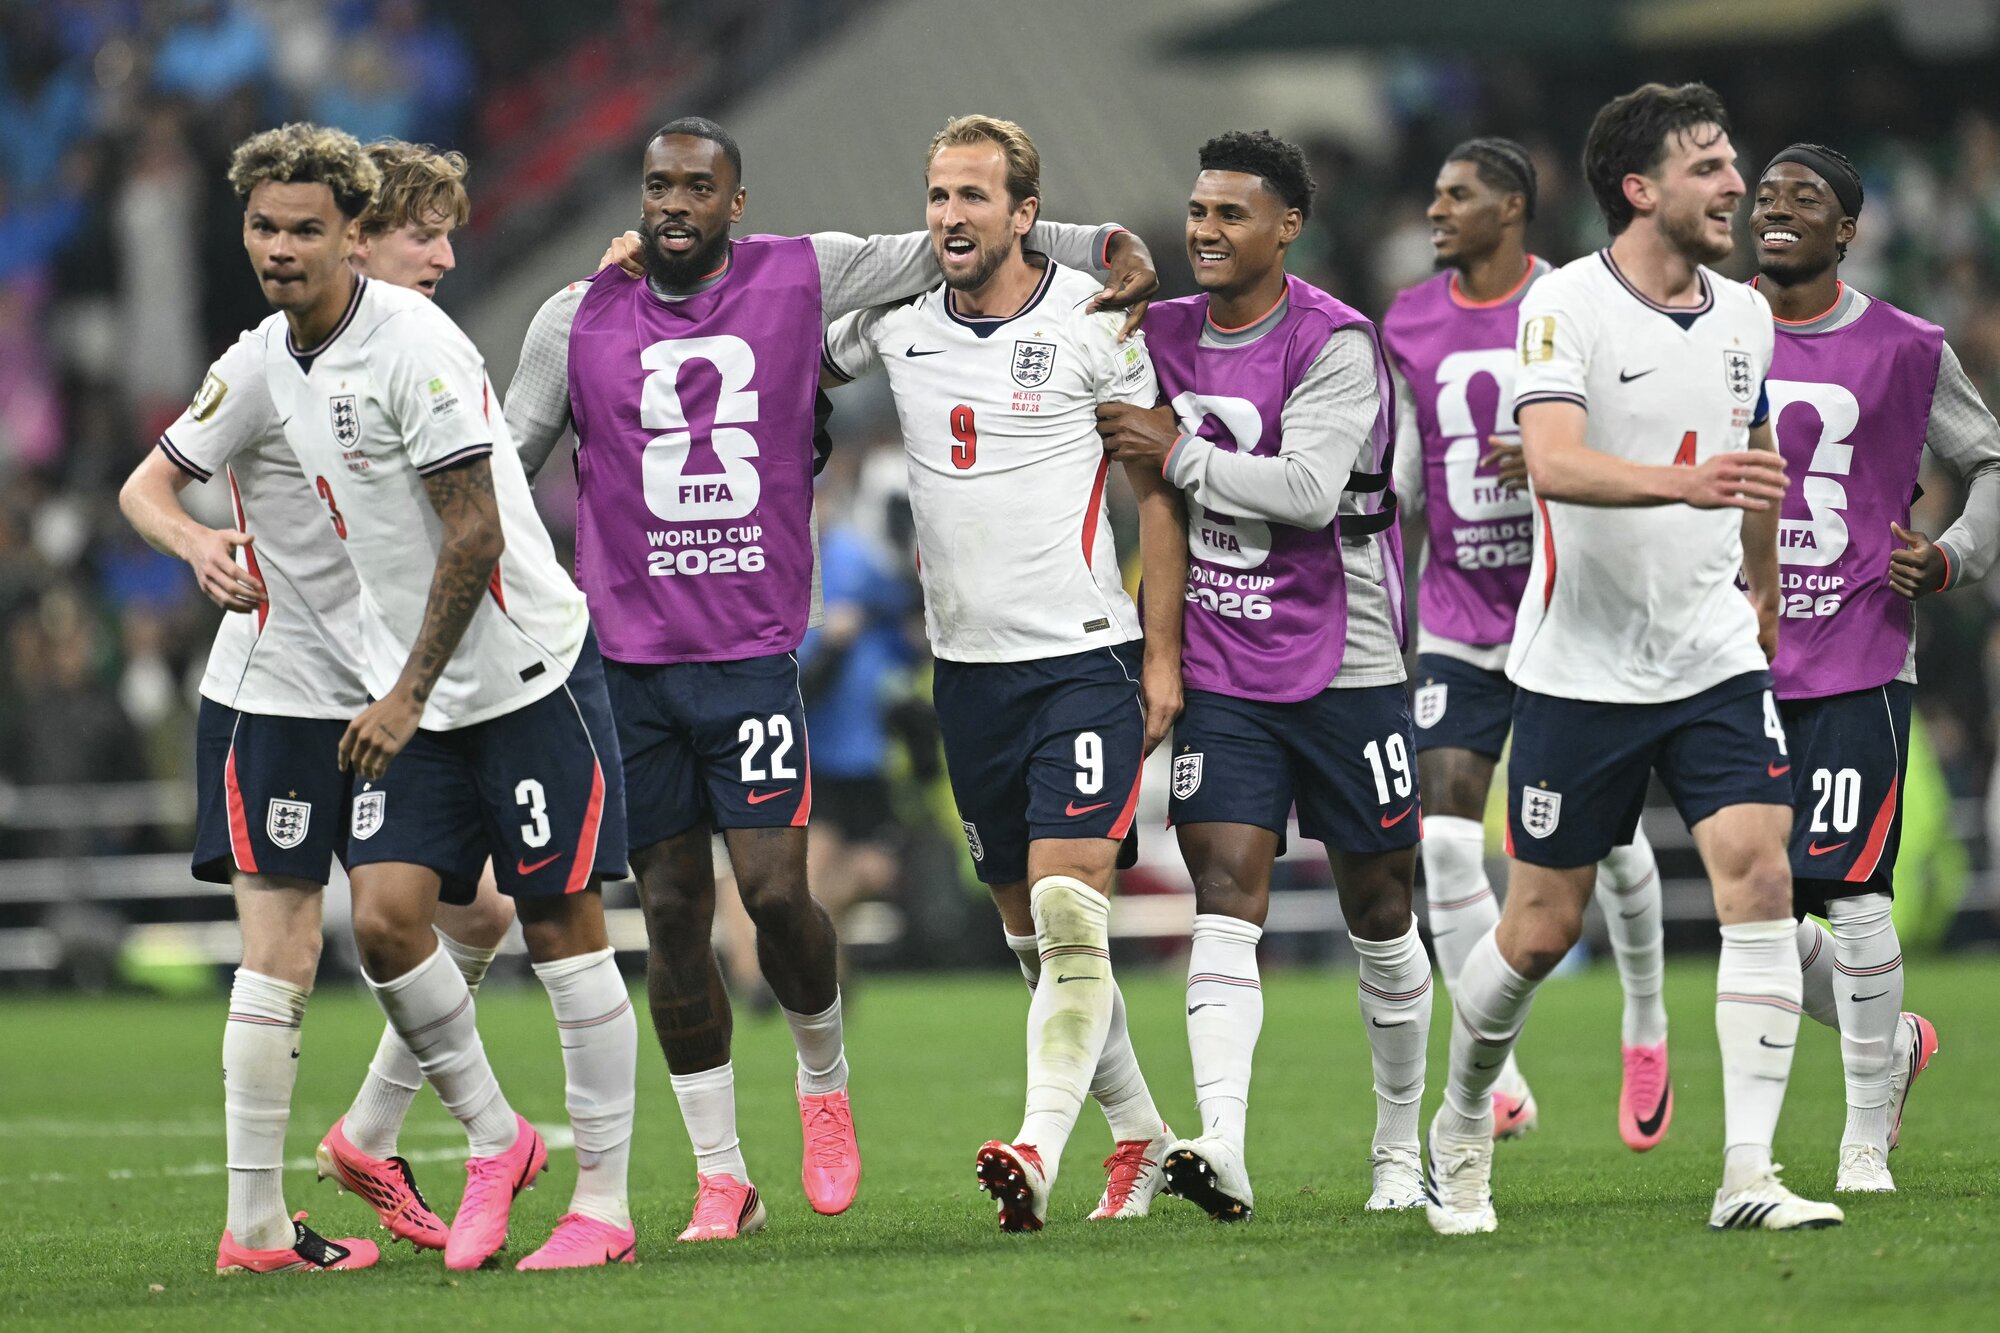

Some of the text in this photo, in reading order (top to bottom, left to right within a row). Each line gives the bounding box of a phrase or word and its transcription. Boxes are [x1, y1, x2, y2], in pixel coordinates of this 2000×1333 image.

[1011, 402, 1040, 412] 05.07.26
[950, 404, 977, 470] 9
[316, 475, 347, 540] 3
[679, 484, 733, 504] FIFA
[1473, 487, 1519, 504] FIFA
[646, 525, 763, 547] WORLD CUP
[1201, 527, 1242, 554] FIFA
[1452, 523, 1515, 544] WORLD
[1777, 528, 1818, 550] IFA
[647, 546, 766, 576] 2026
[1455, 541, 1531, 570] 202
[1190, 565, 1275, 591] ORLD CUP
[1805, 574, 1845, 591] CUP
[1778, 593, 1842, 618] 26
[1762, 689, 1788, 756] 4
[738, 714, 797, 782] 22
[1074, 732, 1104, 794] 9
[1363, 732, 1412, 805] 19
[515, 778, 551, 848] 3
[1809, 768, 1862, 832] 20
